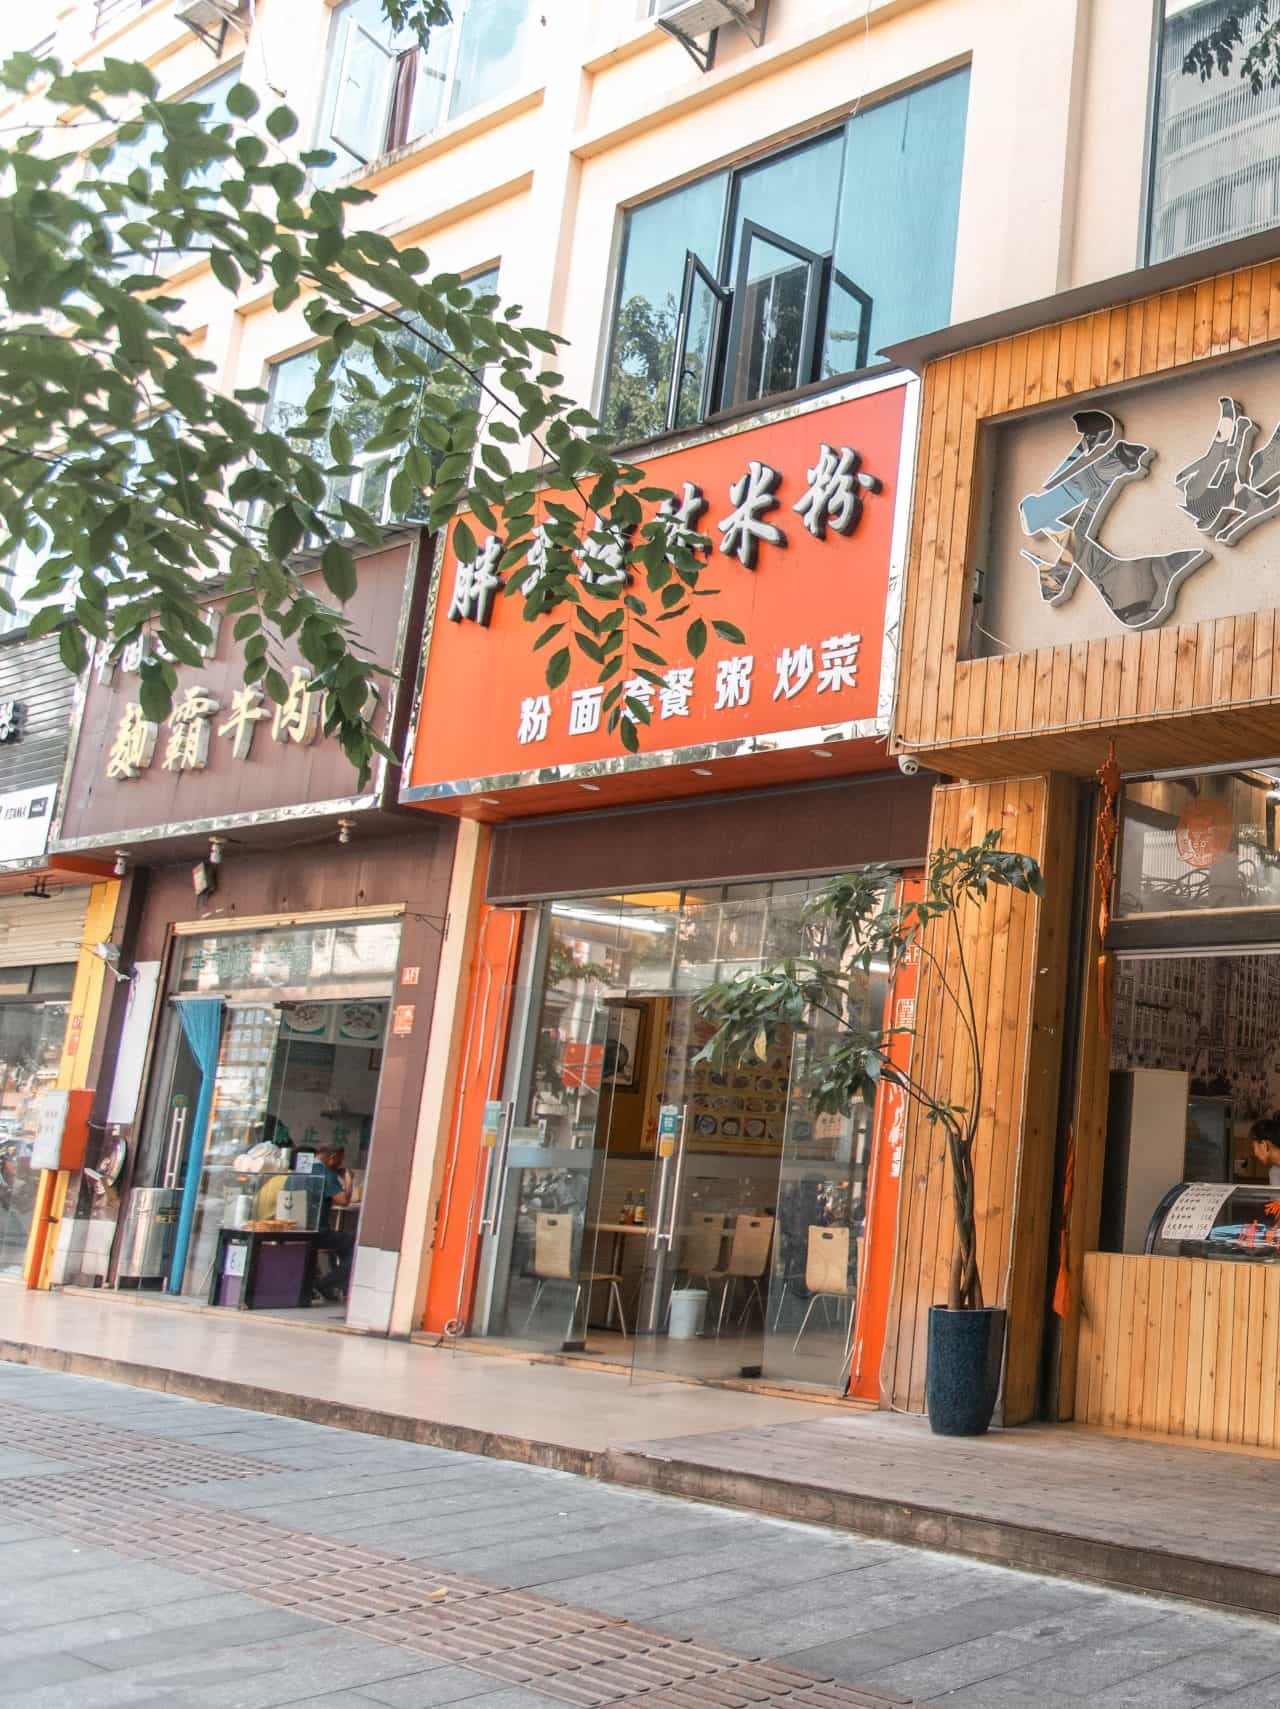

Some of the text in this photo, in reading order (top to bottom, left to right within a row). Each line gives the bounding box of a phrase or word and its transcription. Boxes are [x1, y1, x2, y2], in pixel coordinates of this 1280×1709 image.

[517, 696, 552, 745] 粉
[568, 686, 604, 735] 面
[714, 655, 755, 710] 粥
[773, 632, 863, 702] 炒菜
